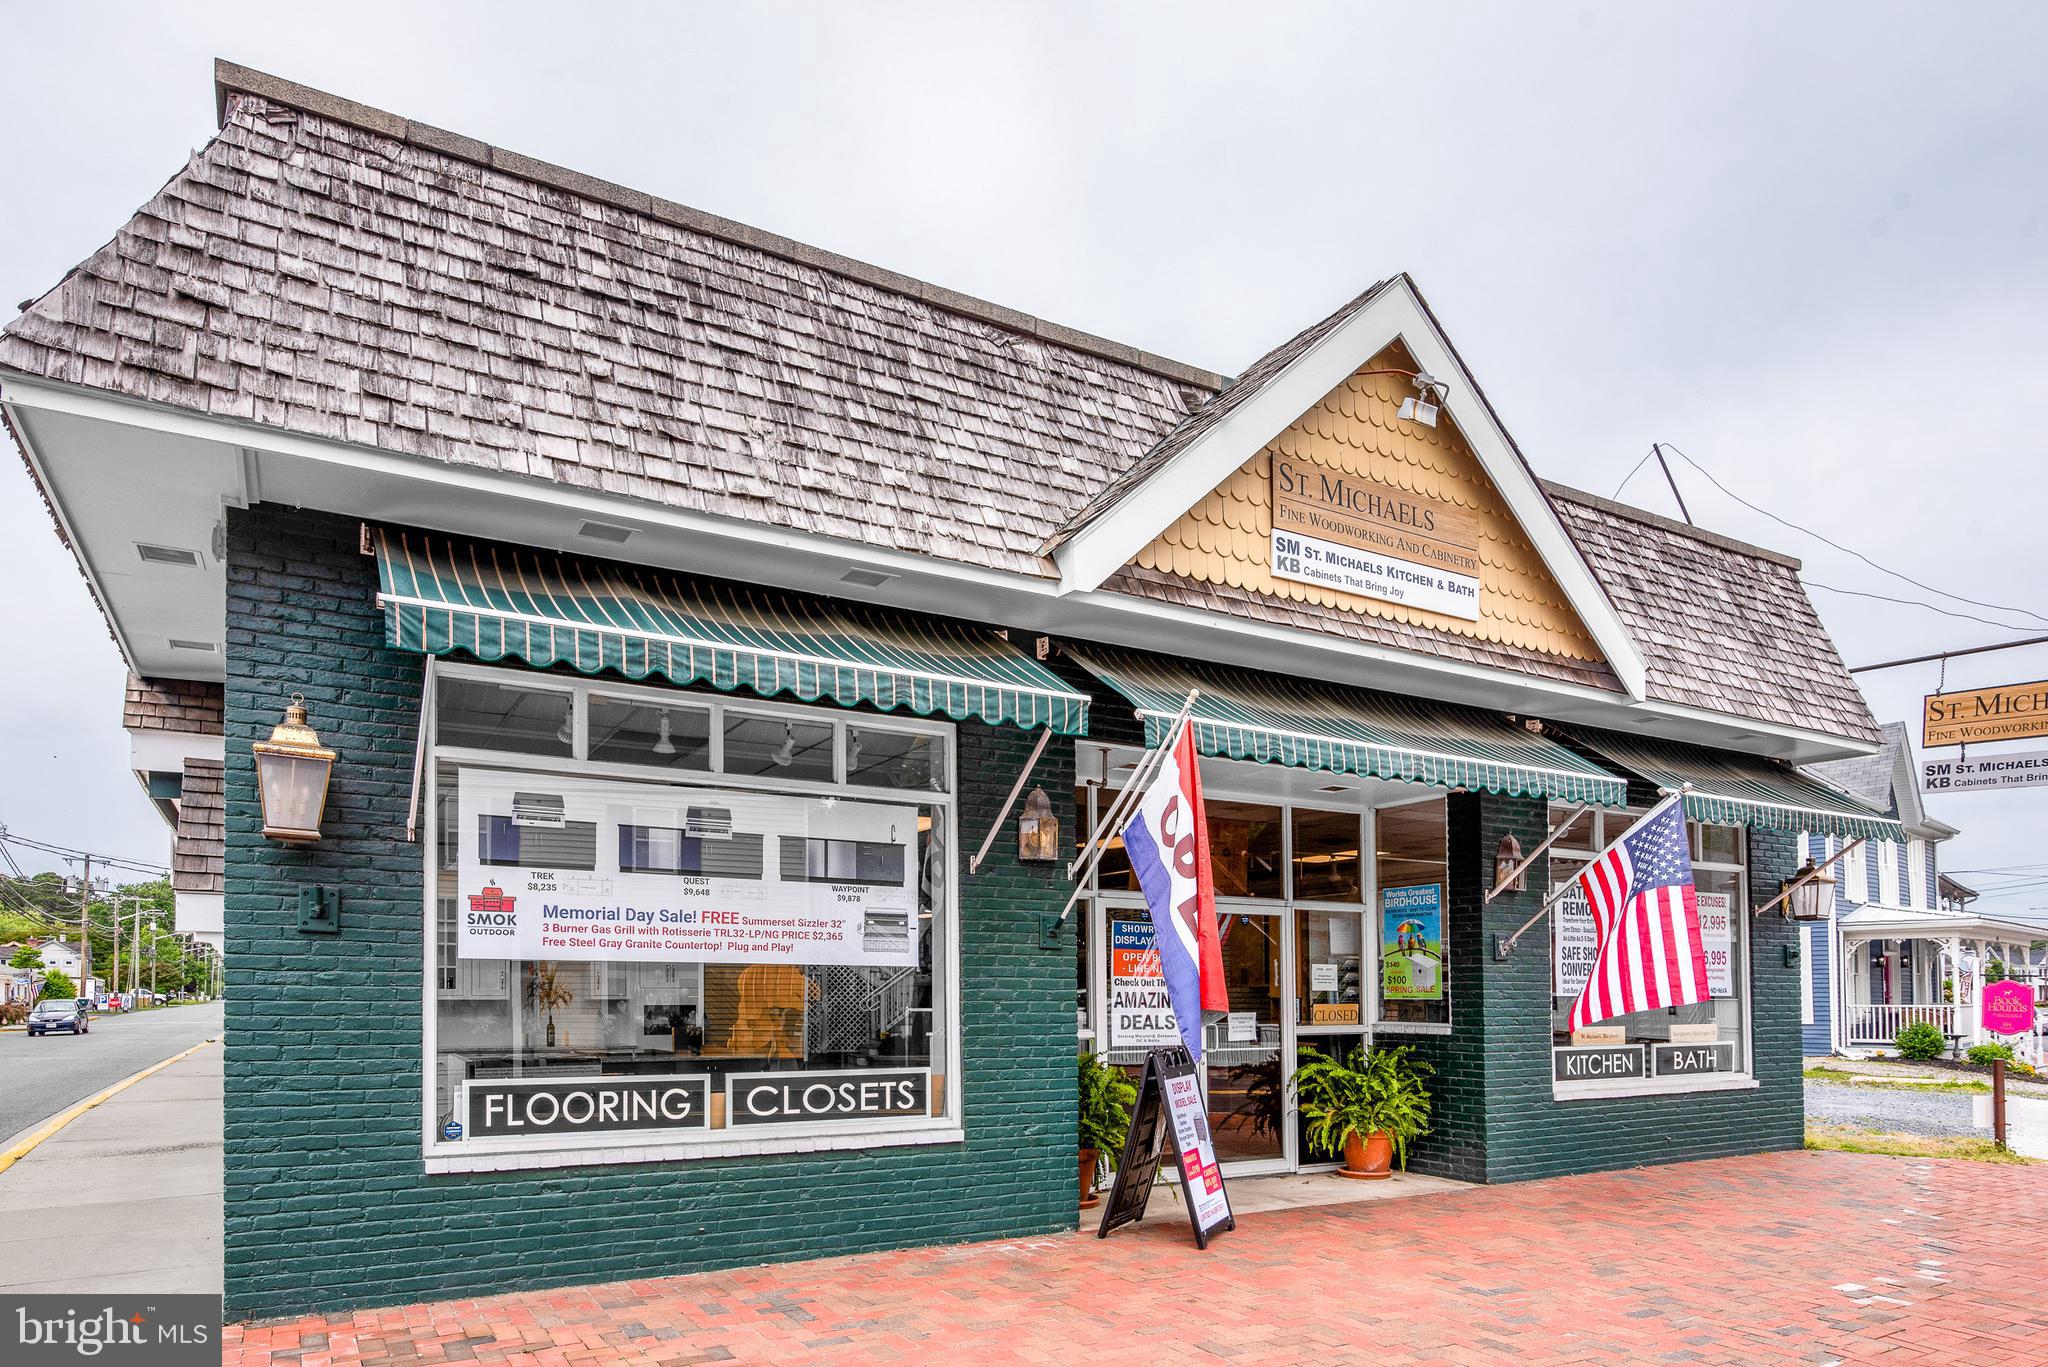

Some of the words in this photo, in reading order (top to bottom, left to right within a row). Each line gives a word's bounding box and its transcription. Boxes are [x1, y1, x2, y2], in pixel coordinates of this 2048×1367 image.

[1279, 462, 1313, 499] ST.
[1319, 473, 1435, 532] MICHAELS
[1279, 503, 1306, 524] FINE
[1309, 511, 1394, 548] WOODWORKING
[1396, 536, 1420, 555] AND
[1422, 543, 1478, 570] CABINETRY
[1275, 535, 1301, 556] SM
[1276, 554, 1301, 574] KB
[1304, 546, 1322, 562] ST.
[1325, 551, 1384, 576] MICHAELS
[1386, 565, 1434, 588] KITCHEN
[1437, 579, 1445, 590] &
[1447, 580, 1476, 599] BATH
[1303, 566, 1343, 584] Cabinets
[1344, 575, 1364, 589] That
[1365, 579, 1388, 595] Bring
[1389, 585, 1405, 600] Joy
[1929, 699, 1965, 722] ST.
[1927, 729, 1956, 742] FINE
[1925, 763, 1951, 777] SM
[1955, 764, 1975, 775] ST.
[1926, 776, 1951, 790] KB
[1954, 776, 1998, 788] Cabinets
[2001, 773, 2023, 784] That
[530, 871, 555, 881] TREK
[683, 876, 710, 886] QUEST
[527, 882, 558, 892] $8,235
[683, 887, 711, 897] $9,648
[831, 884, 870, 894] WAYPOINT
[1385, 890, 1407, 898] Worlds
[1407, 887, 1435, 896] Greatest
[836, 894, 861, 903] $9,878
[1384, 895, 1438, 908] BIRDHOUSE
[1701, 895, 1727, 908] EXCUSES!
[467, 912, 518, 926] SMOK
[542, 904, 624, 922] Memorial
[625, 907, 655, 925] Day
[658, 909, 697, 924] Sale!
[701, 910, 740, 926] FREE
[741, 915, 796, 928] Summerset
[797, 917, 829, 928] Sizzler
[469, 928, 516, 936] OUTDOOR
[542, 922, 550, 933] 3
[552, 923, 589, 934] Burner
[591, 924, 611, 935] Gas
[614, 924, 635, 935] Grill
[637, 925, 660, 936] with
[661, 926, 712, 938] Rotisserie
[713, 929, 780, 940] TRL32-LP/NG
[781, 929, 811, 941] PRICE
[812, 930, 844, 942] $2,365
[542, 936, 566, 947] Free
[568, 937, 596, 948] Steel
[598, 938, 623, 950] Gray
[625, 938, 662, 949] Granite
[664, 939, 723, 951] Countertop!
[727, 941, 749, 952] Plug
[751, 942, 769, 951] and
[771, 943, 795, 953] Play!
[1115, 935, 1152, 946] DISPLAY
[1122, 952, 1151, 962] OPEN
[1561, 946, 1581, 961] SAFE
[1128, 964, 1150, 973] LIKE
[1561, 962, 1595, 977] CONVER
[1114, 977, 1139, 987] Check
[1140, 978, 1155, 987] Out
[1387, 975, 1407, 985] $100
[1385, 985, 1413, 994] SPRING
[1415, 984, 1435, 993] SALE
[1993, 996, 2021, 1005] Book
[1987, 1003, 2028, 1013] Hounds
[1119, 1014, 1176, 1031] DEALS
[1314, 1009, 1359, 1022] CLOSED
[1566, 1053, 1633, 1076] KITCHEN
[1673, 1049, 1717, 1070] BATH
[1171, 1079, 1193, 1095] DISPLAY
[746, 1080, 915, 1117] CLOSETS
[485, 1087, 692, 1128] FLOORING
